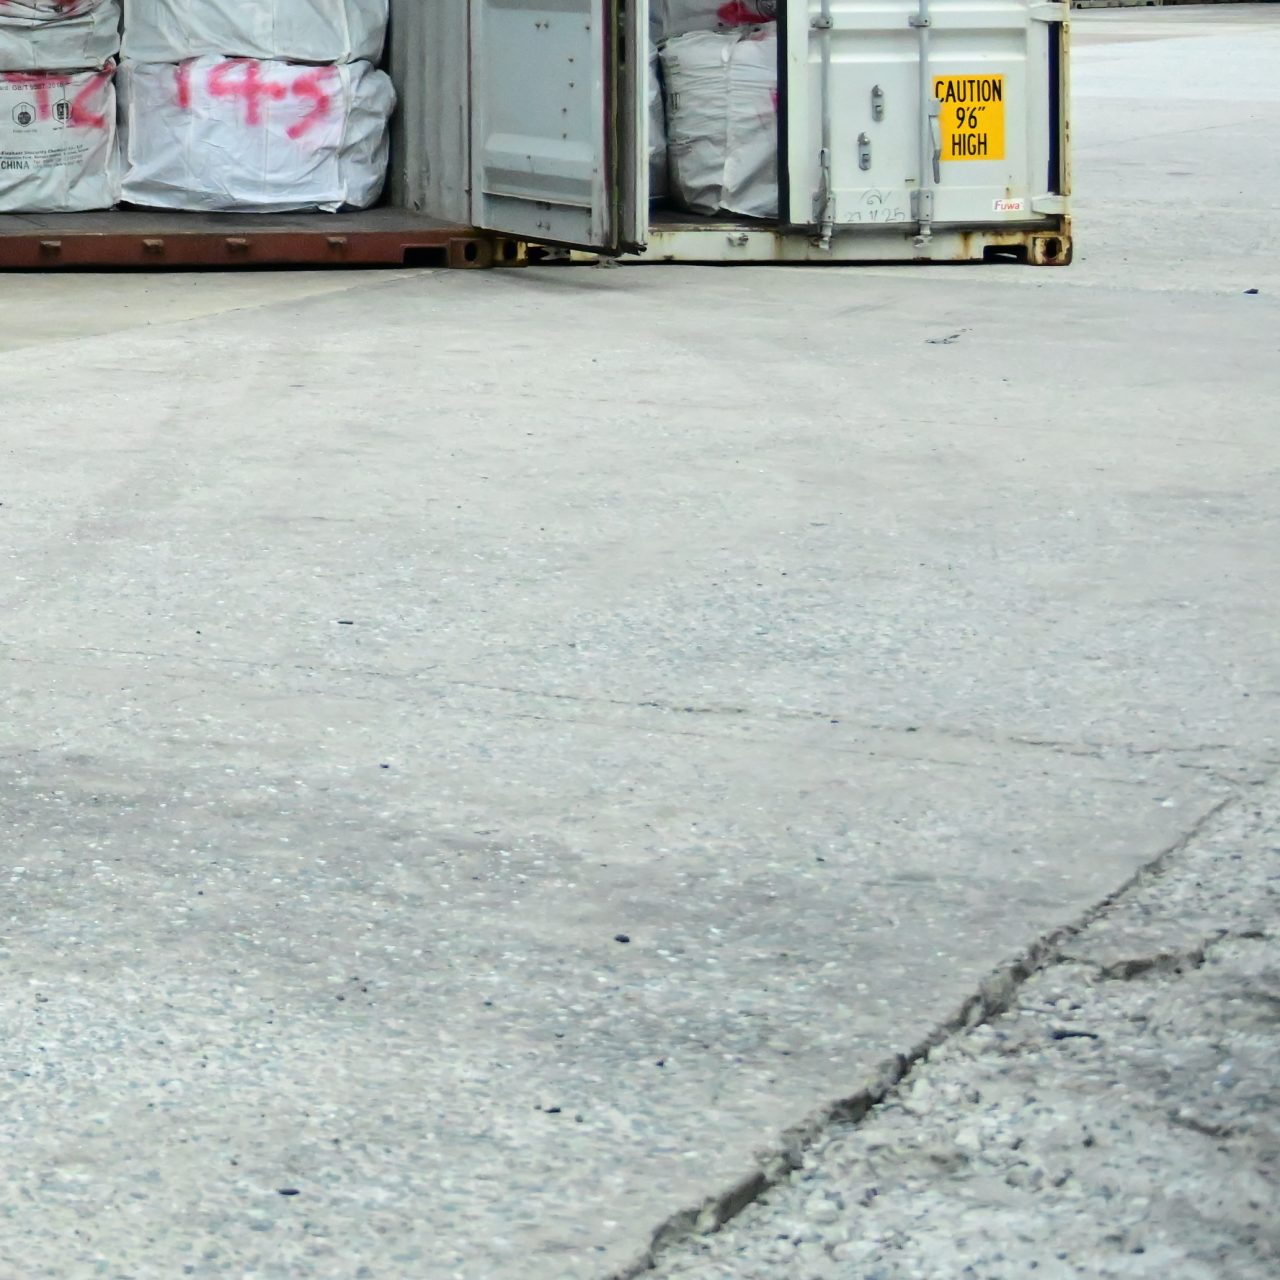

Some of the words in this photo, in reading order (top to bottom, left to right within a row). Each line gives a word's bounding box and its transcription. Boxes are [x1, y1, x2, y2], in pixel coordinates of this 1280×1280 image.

[935, 79, 1003, 103] CAUTION
[951, 133, 988, 156] HIGH
[1, 160, 30, 170] CHINA
[994, 199, 1021, 211] Fuwa
